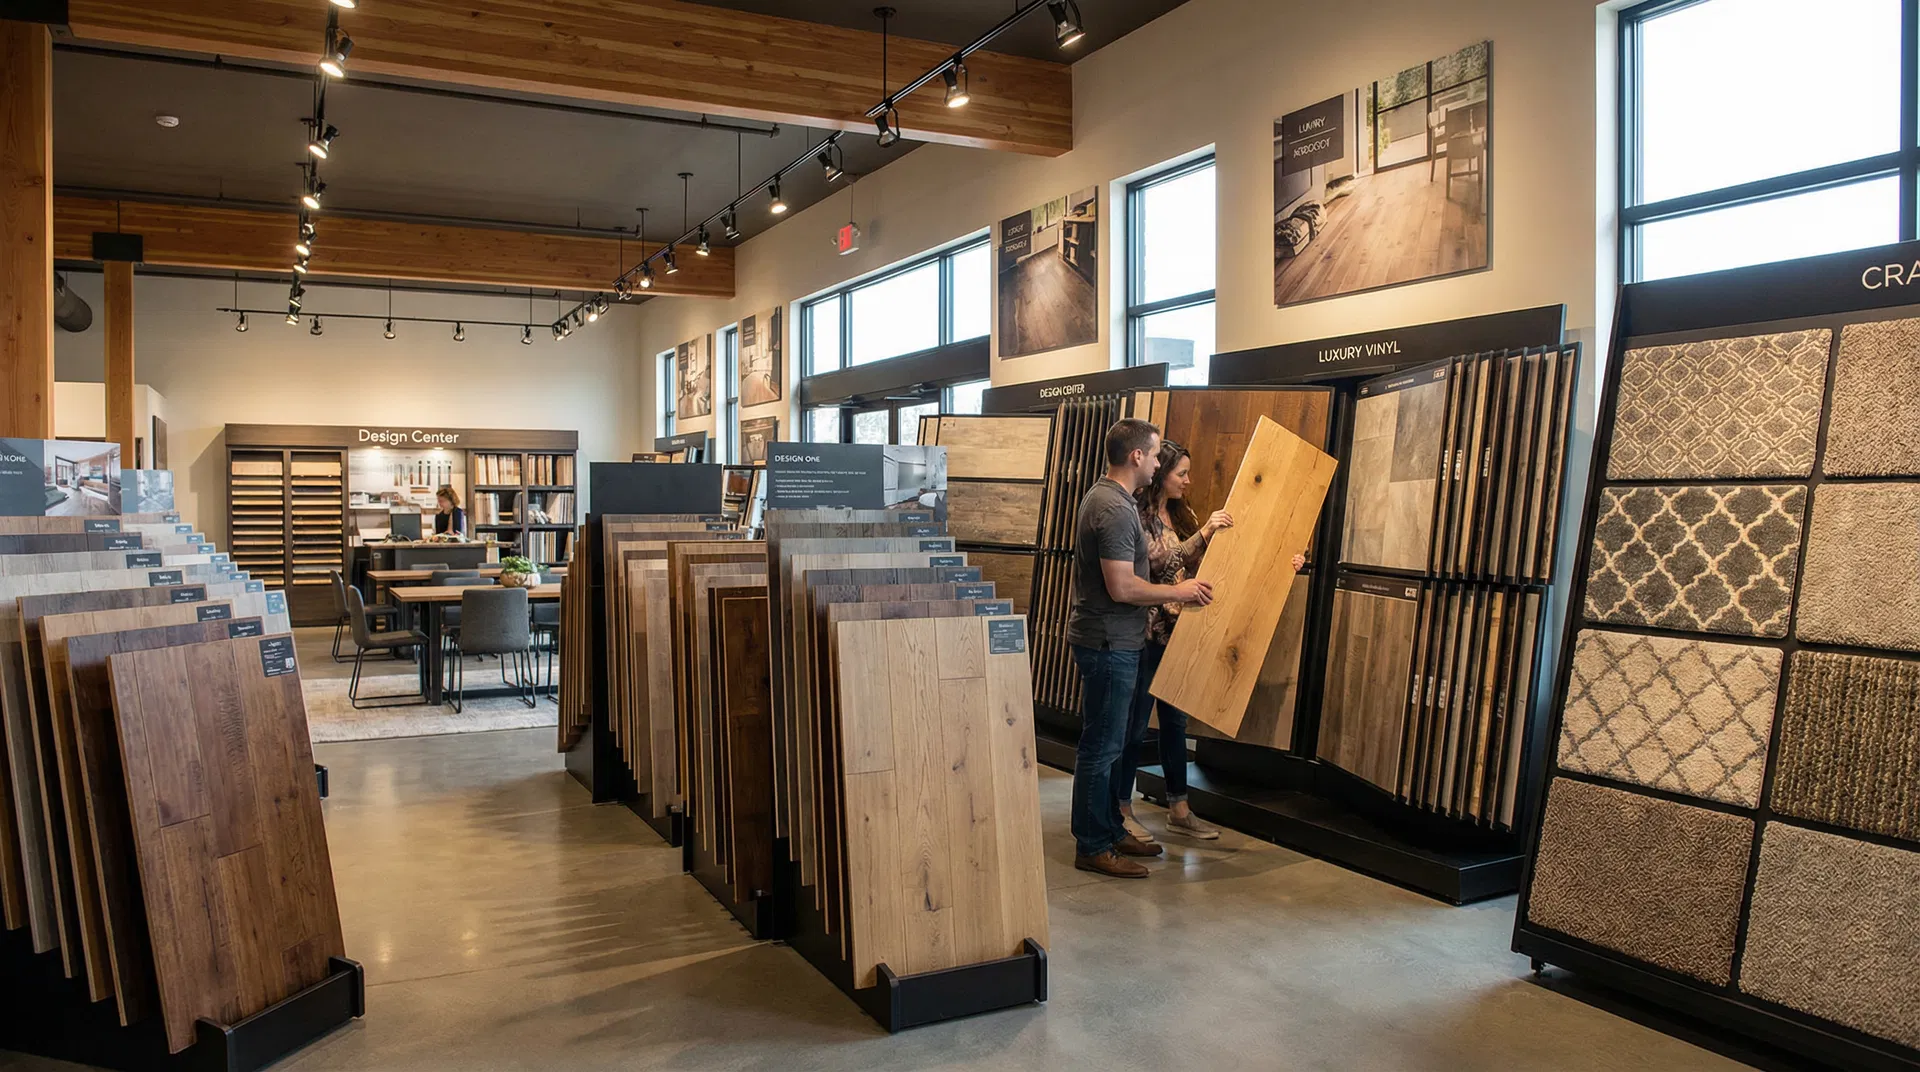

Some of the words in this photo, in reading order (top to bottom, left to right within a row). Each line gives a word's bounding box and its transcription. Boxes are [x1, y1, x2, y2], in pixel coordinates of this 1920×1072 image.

[1318, 345, 1362, 363] LUXURY
[1365, 340, 1401, 357] VINYL
[358, 428, 408, 446] Design
[411, 429, 460, 444] Center
[774, 454, 804, 463] DESIGN
